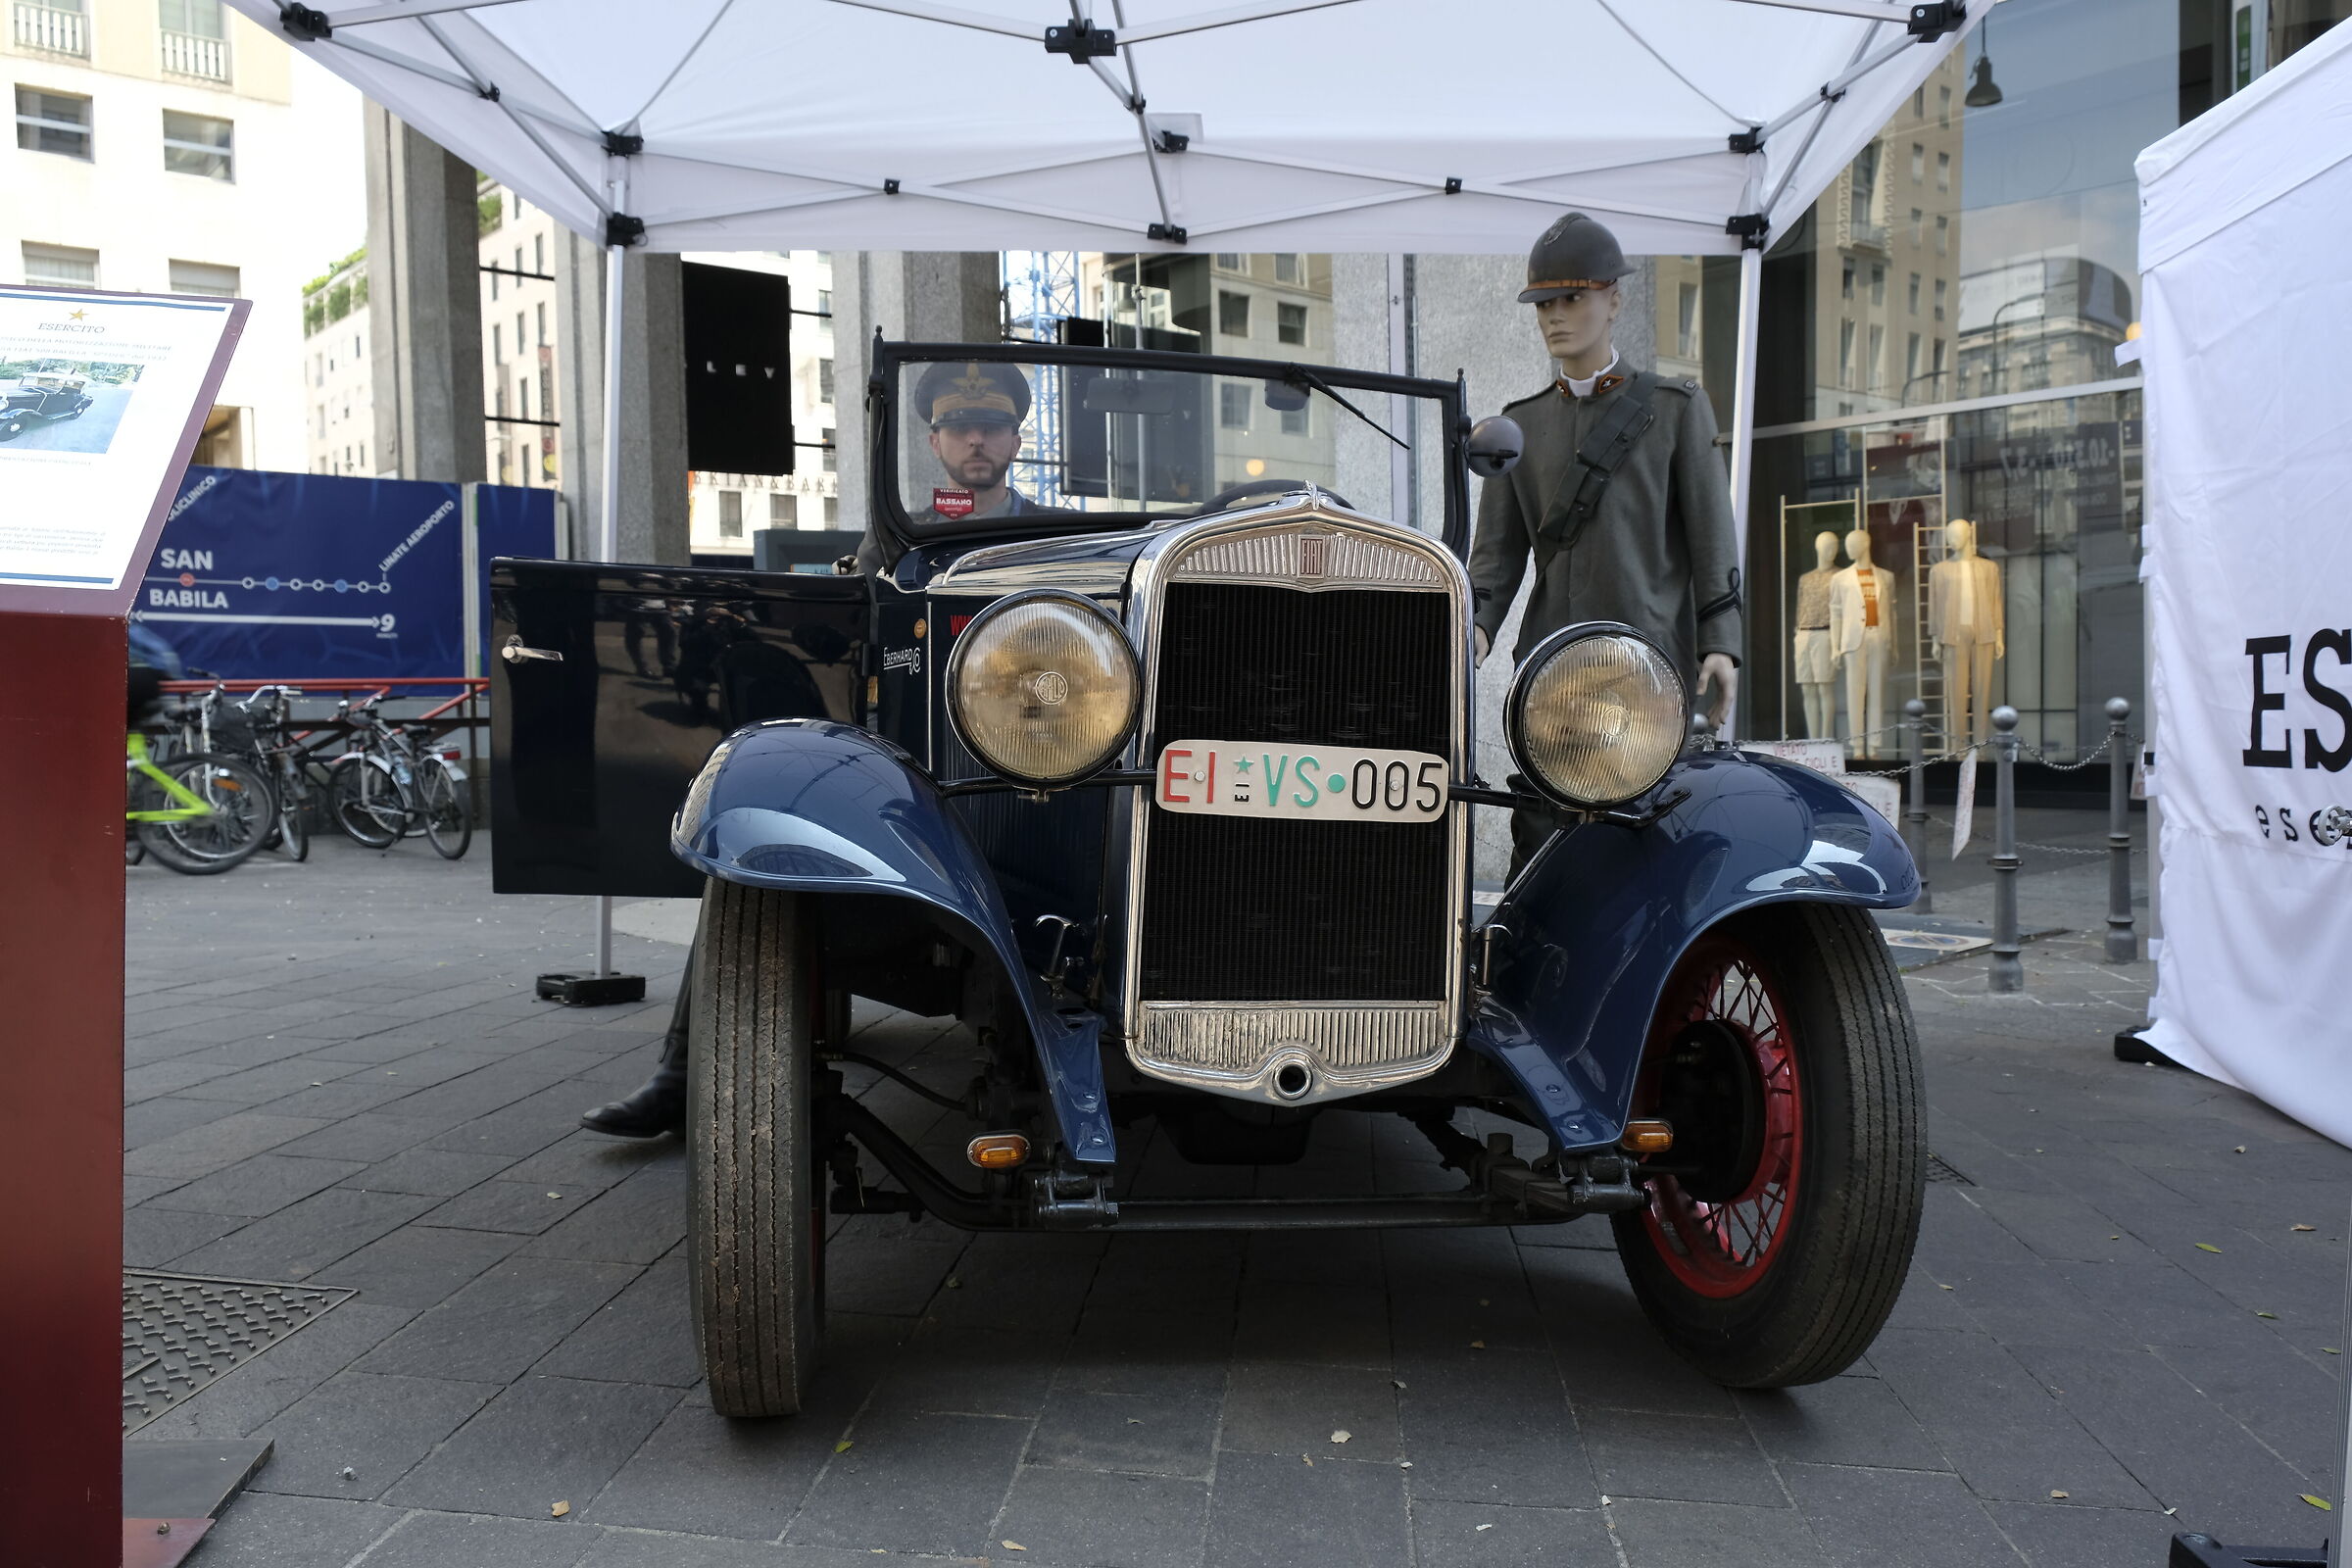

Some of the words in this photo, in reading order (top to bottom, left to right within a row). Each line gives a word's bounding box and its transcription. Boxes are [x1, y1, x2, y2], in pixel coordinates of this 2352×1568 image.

[37, 321, 106, 335] ESERCITO
[936, 497, 972, 506] BASSANO
[378, 542, 410, 572] LINATE
[406, 500, 455, 548] AEROPORTO
[161, 548, 214, 571] SAN
[1300, 539, 1323, 574] FIAT
[149, 588, 229, 610] BABILA
[379, 612, 396, 632] 9
[1262, 754, 1321, 808] VS
[1351, 759, 1443, 813] 005
